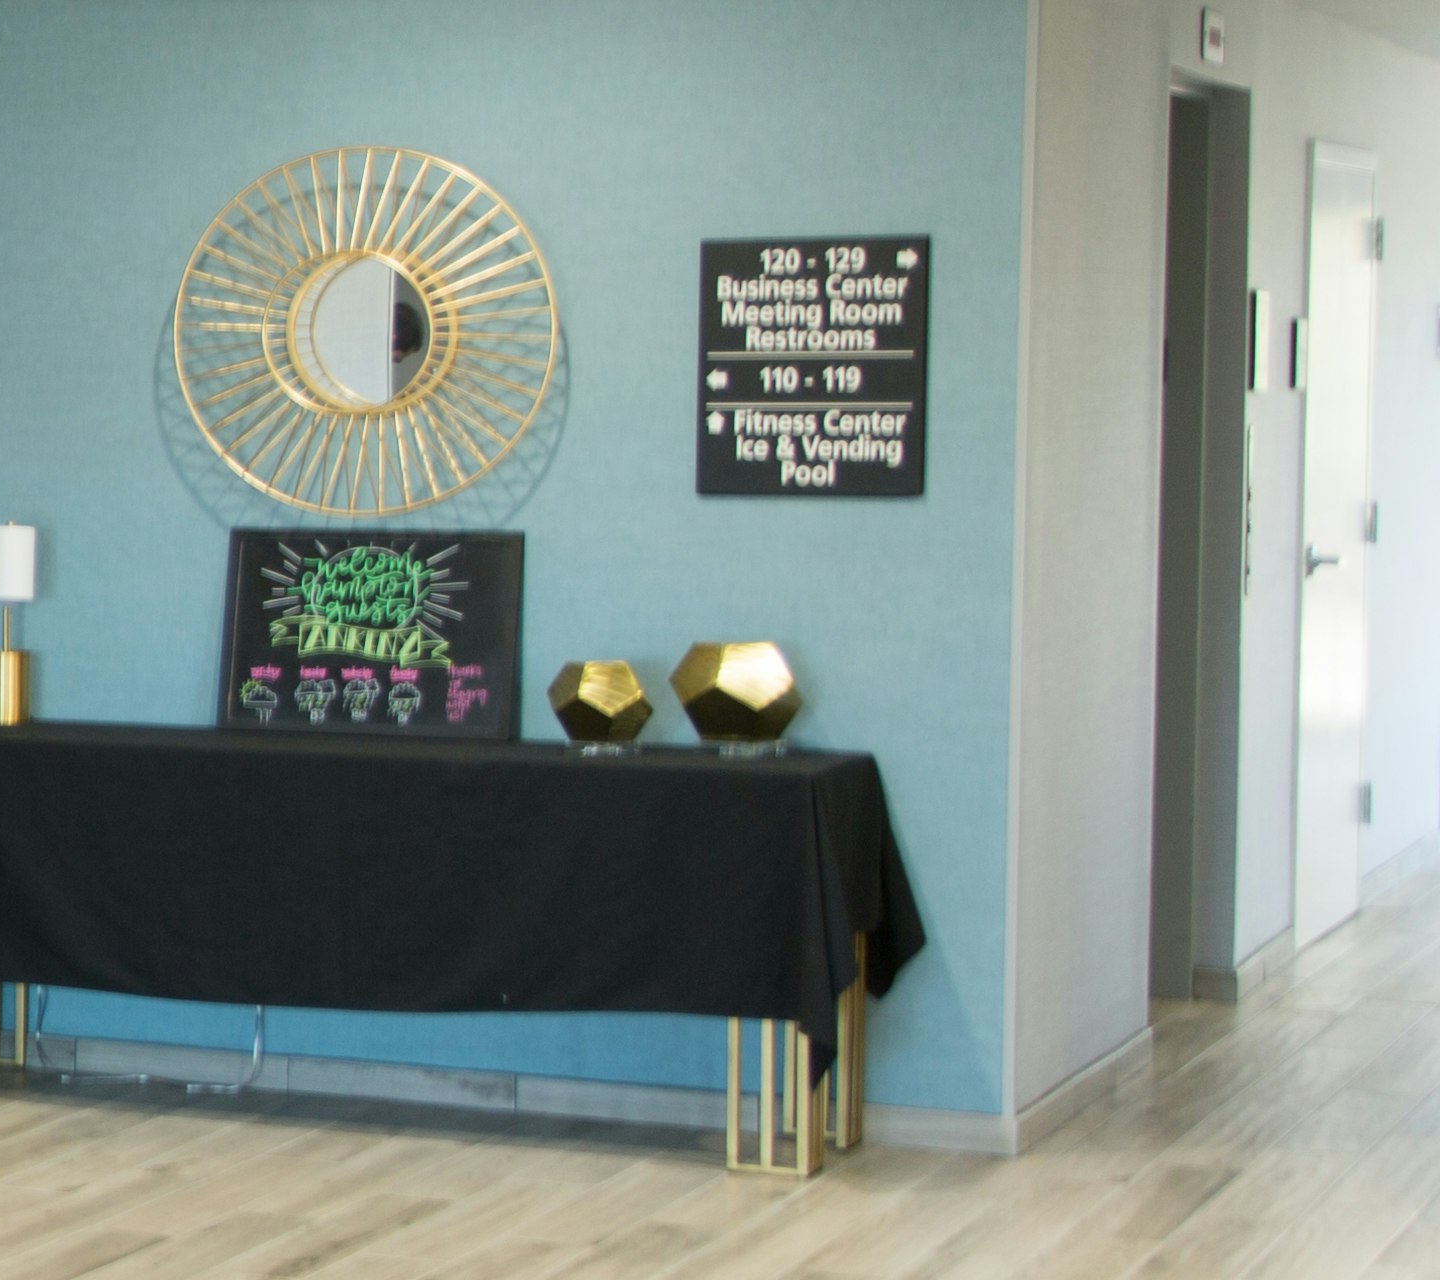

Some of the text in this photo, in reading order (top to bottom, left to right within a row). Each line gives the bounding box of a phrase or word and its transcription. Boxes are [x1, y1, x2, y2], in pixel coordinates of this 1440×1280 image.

[760, 247, 801, 275] 120
[825, 247, 866, 274] 129
[717, 273, 909, 302] Business Center
[721, 298, 902, 329] Meeting Room
[746, 325, 876, 351] Restrooms
[760, 366, 799, 393] 110
[823, 366, 862, 393] 119
[734, 409, 906, 436] Fitness Center
[735, 433, 903, 468] Ice & Vending
[781, 459, 836, 487] Pool
